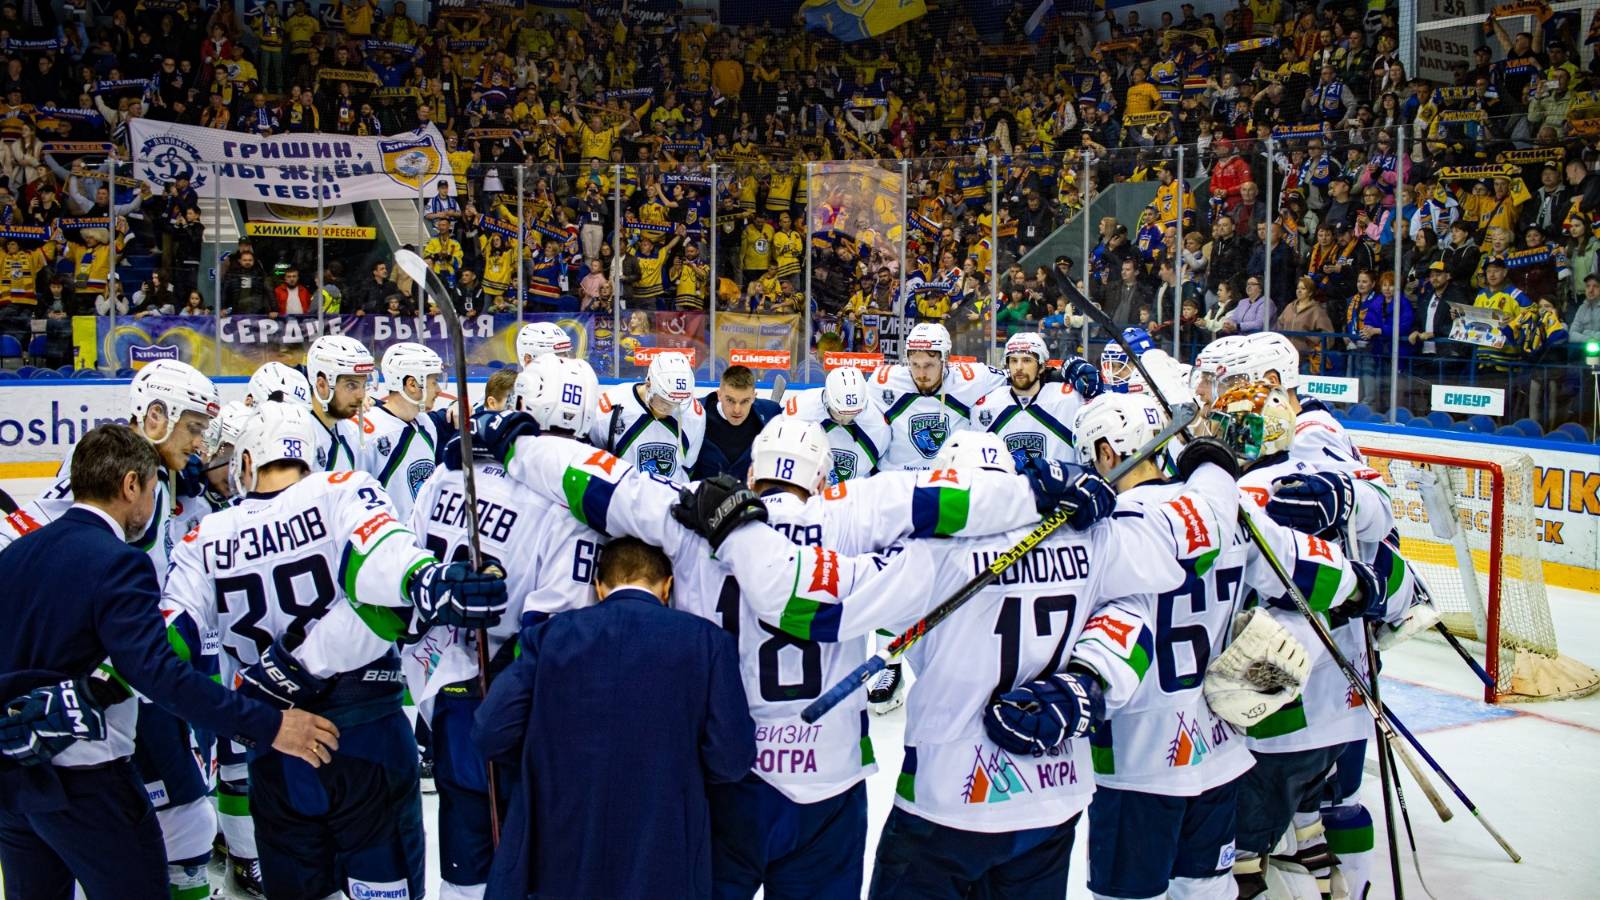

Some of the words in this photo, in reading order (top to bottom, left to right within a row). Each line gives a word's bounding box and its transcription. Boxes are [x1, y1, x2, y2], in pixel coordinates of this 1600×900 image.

[223, 140, 363, 160] ГРИШИН,
[213, 163, 265, 180] МЫ
[279, 160, 374, 183] ЖДЁМ
[254, 183, 341, 200] ТЕБЯ!
[253, 225, 301, 236] ХИМИК
[306, 226, 367, 238] ВОКРЕСЕНСК
[220, 316, 344, 344] СЕРДЦЕ
[730, 354, 789, 364] OLIMPBET
[825, 357, 882, 367] OLIMPBET
[293, 385, 306, 401] 42
[675, 378, 687, 391] 55
[1307, 381, 1348, 395] СИБУР
[561, 383, 583, 406] 66
[845, 394, 858, 406] 85
[1444, 392, 1491, 408] СИБУР
[1143, 407, 1160, 425] 67
[283, 439, 302, 458] 38
[981, 447, 1000, 465] 12
[775, 457, 795, 480] 18
[202, 506, 327, 574] ГУРЗАНОВ
[215, 553, 336, 666] 38
[993, 594, 1077, 693] 17
[60, 679, 90, 733] CCM
